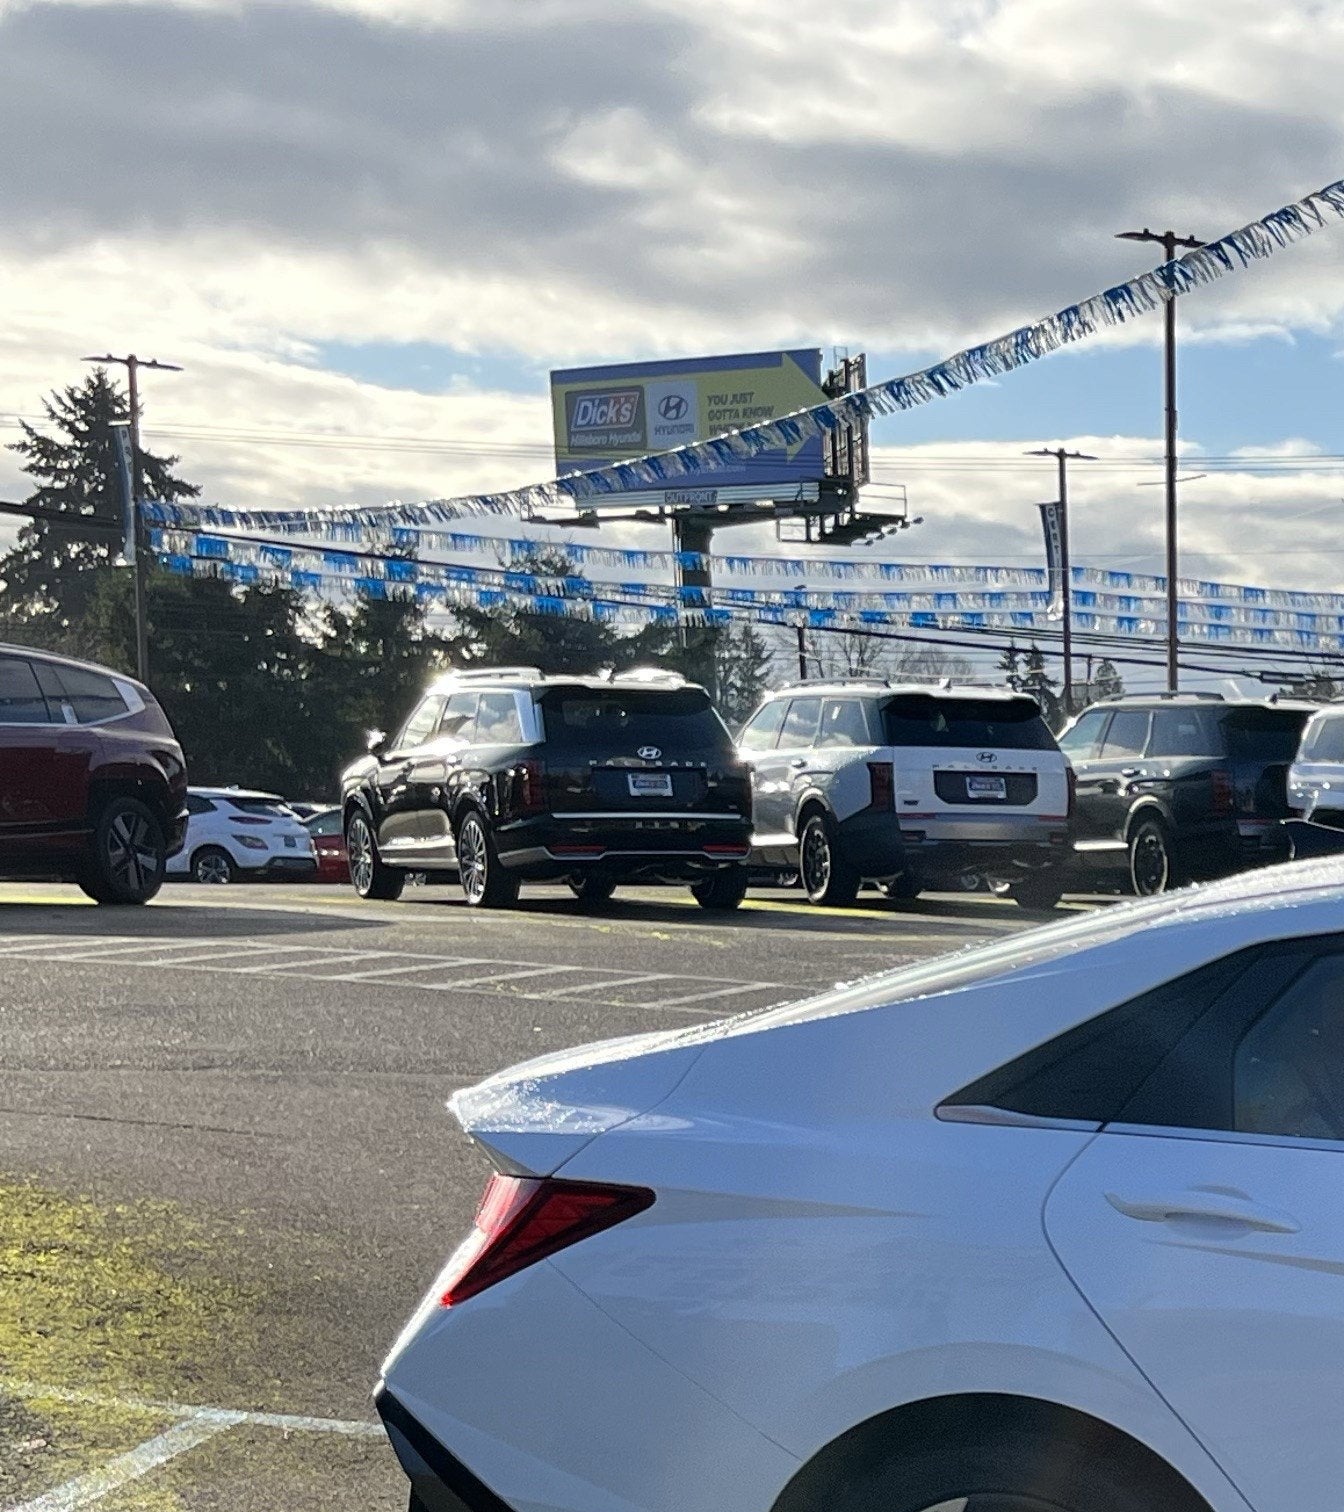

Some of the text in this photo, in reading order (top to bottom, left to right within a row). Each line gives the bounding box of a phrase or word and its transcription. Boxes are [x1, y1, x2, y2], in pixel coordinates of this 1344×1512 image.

[707, 392, 755, 406] YOU JUST
[576, 397, 632, 426] Dick's
[708, 405, 775, 421] GOTTA KNOW
